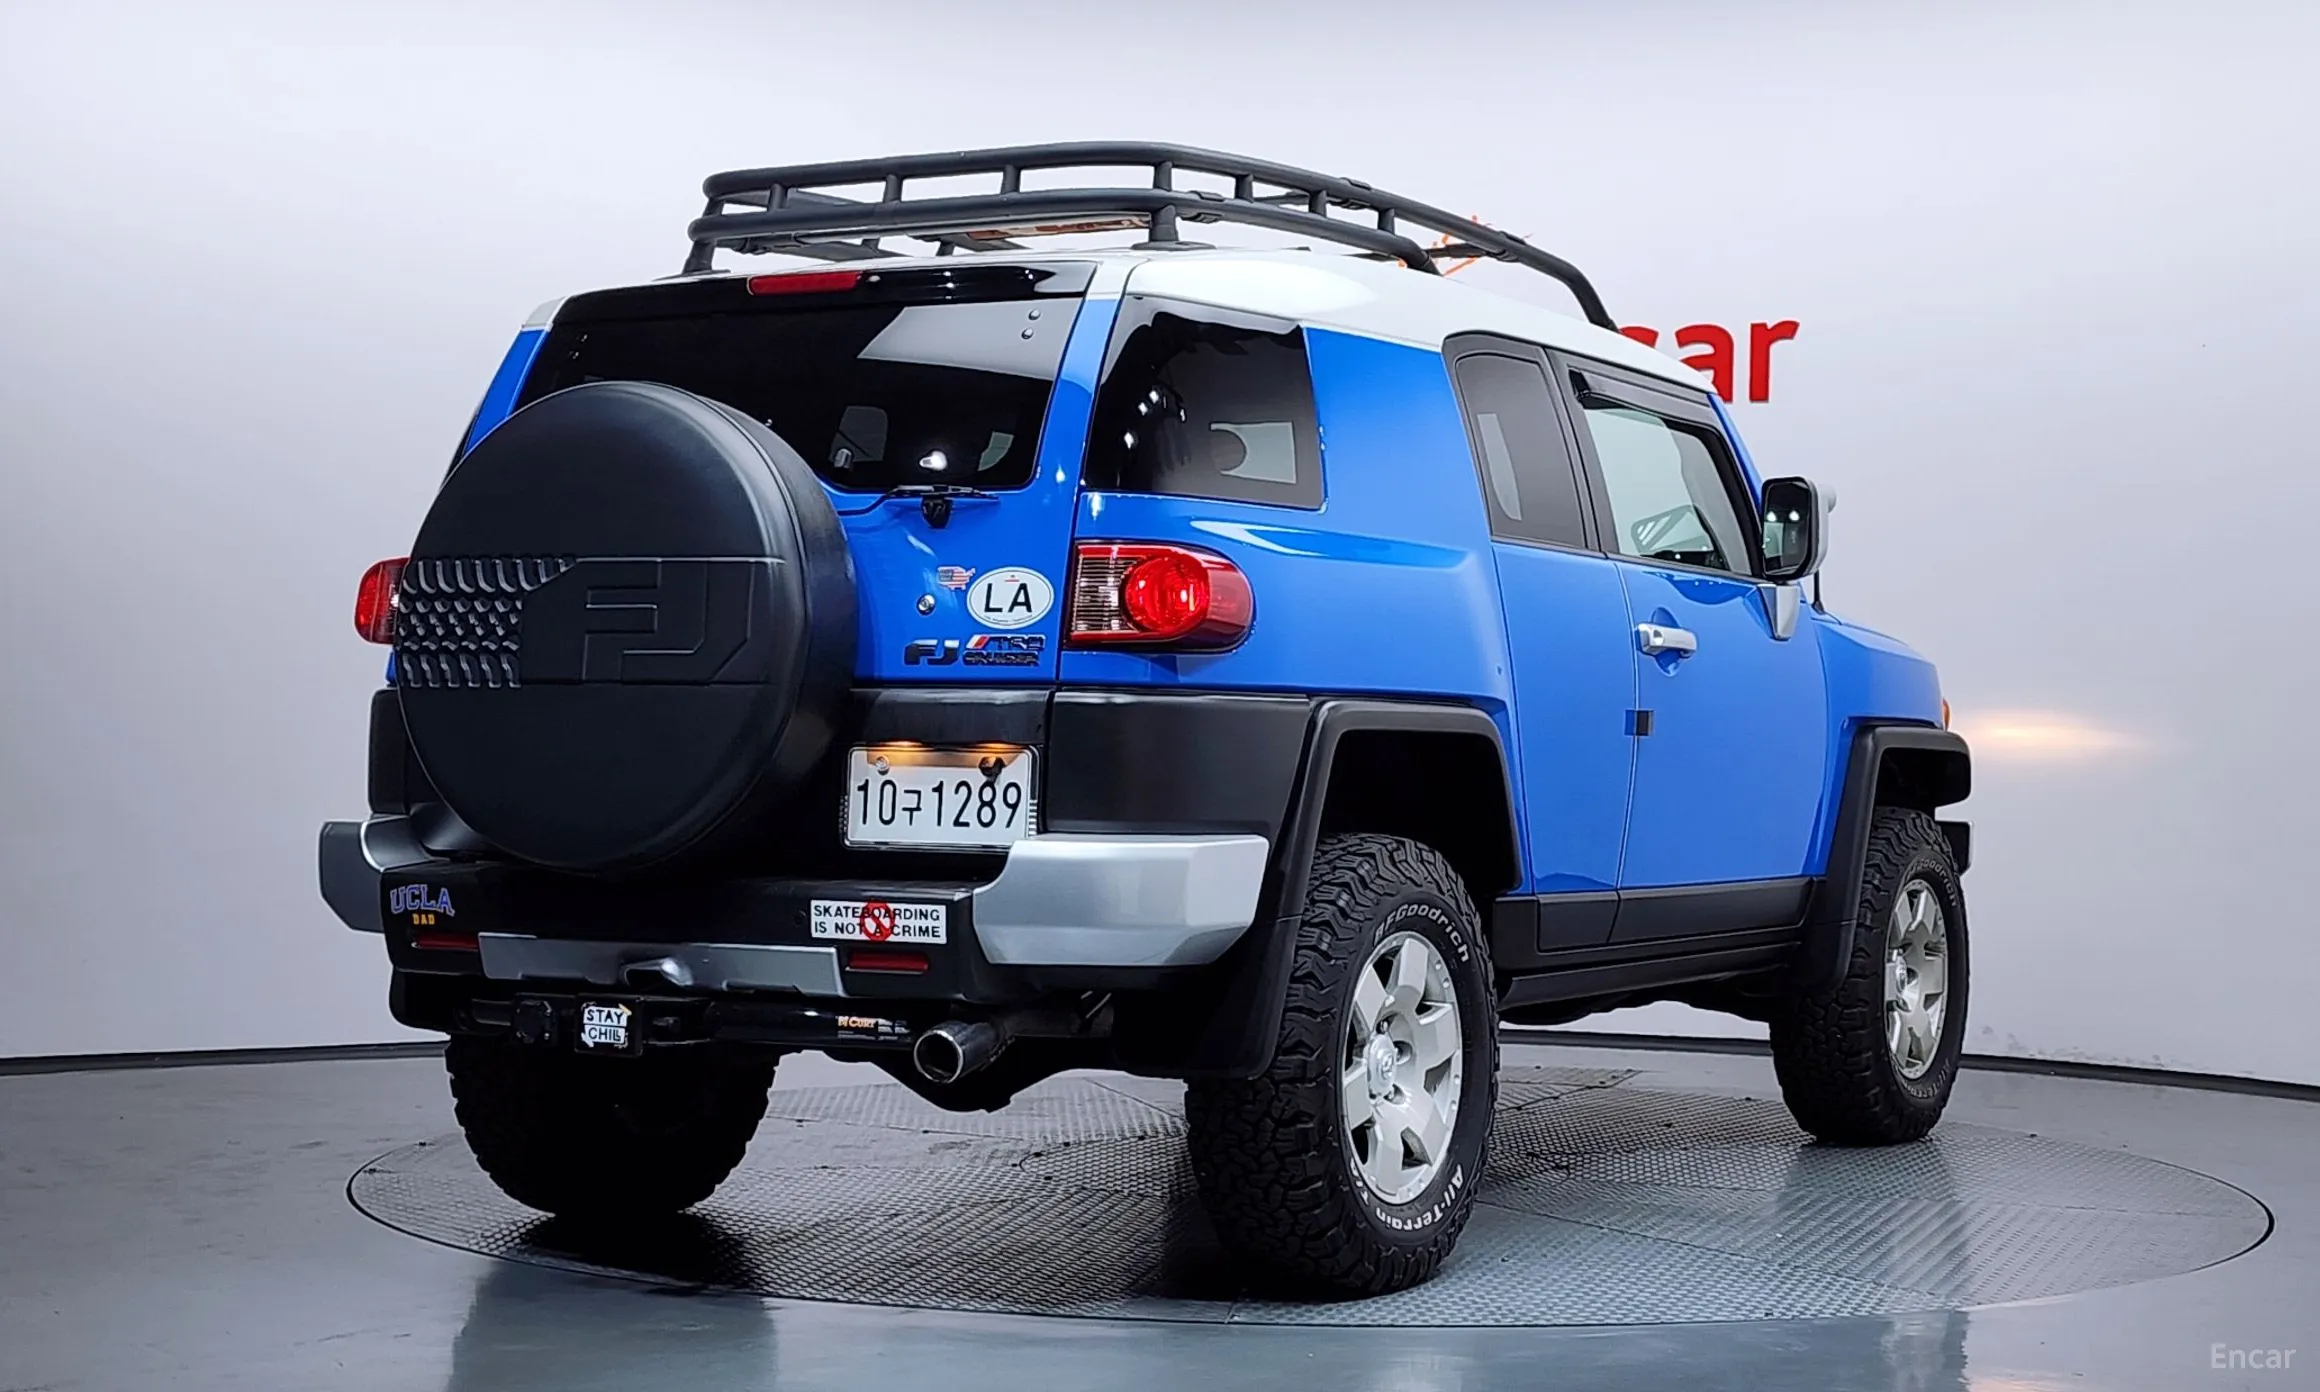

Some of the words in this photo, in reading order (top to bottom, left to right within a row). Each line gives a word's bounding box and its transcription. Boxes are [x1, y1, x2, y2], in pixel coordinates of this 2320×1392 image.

[1619, 320, 1799, 403] ar
[984, 582, 1033, 613] LA
[550, 557, 755, 686] FJ
[904, 639, 960, 666] FJ
[857, 778, 1023, 829] 10구1289
[390, 883, 456, 917] UCLA
[813, 904, 941, 922] SKATEBOARDING
[412, 913, 436, 925] DAD
[814, 921, 828, 934] IS
[834, 922, 864, 936] NOT
[891, 924, 942, 939] CRIME
[586, 1008, 624, 1025] STAY
[588, 1027, 621, 1042] CHILL
[1375, 1164, 1464, 1231] All-Terrain
